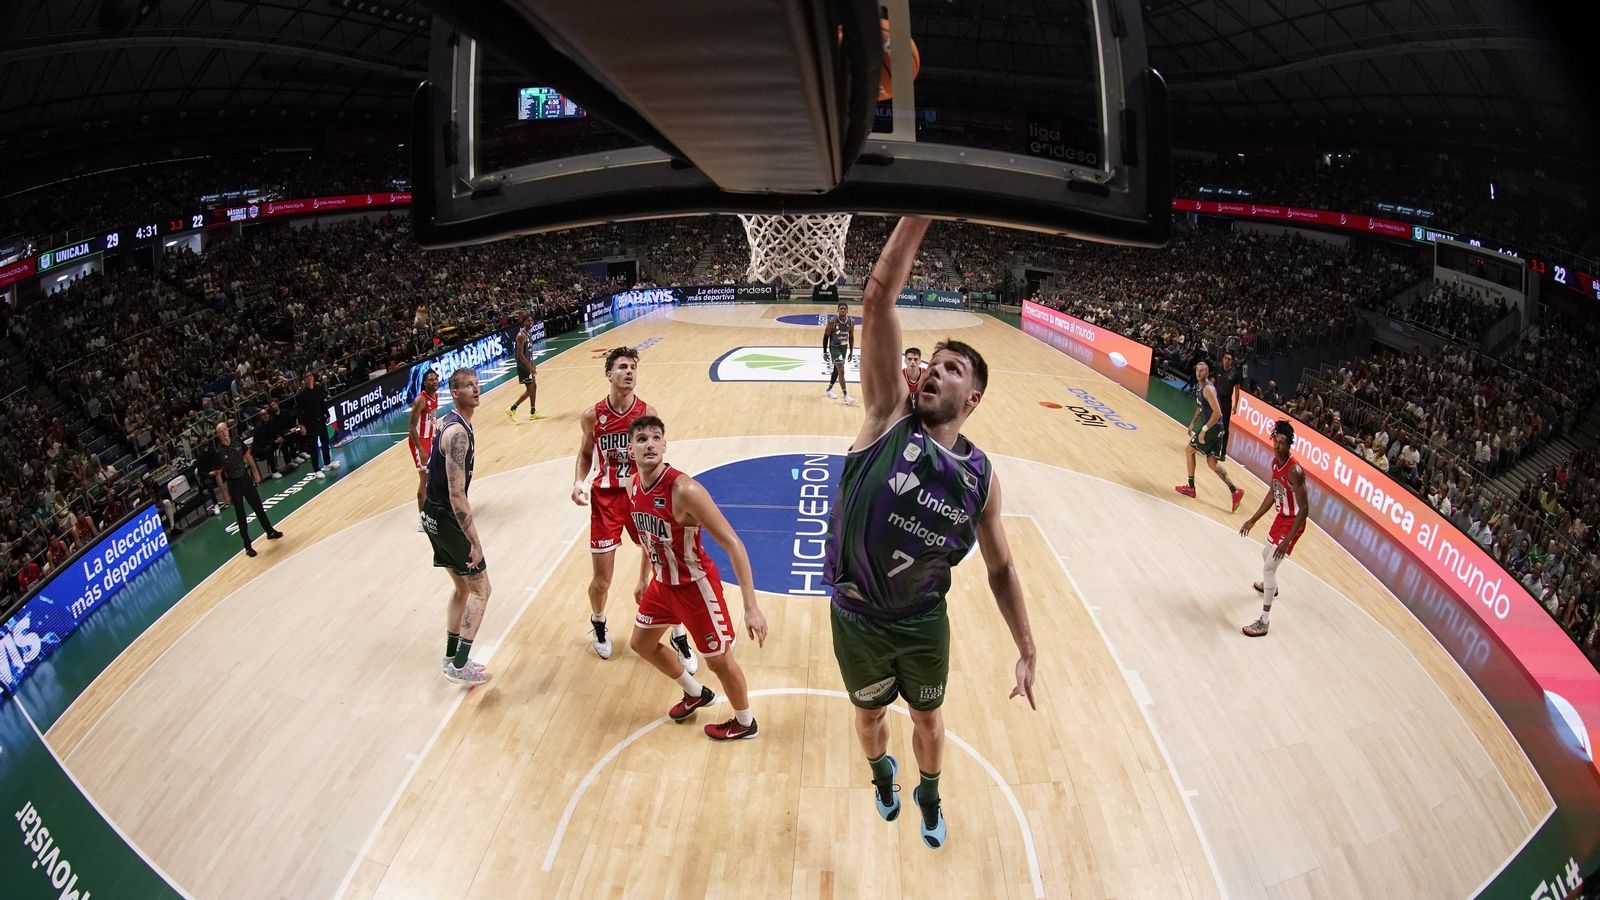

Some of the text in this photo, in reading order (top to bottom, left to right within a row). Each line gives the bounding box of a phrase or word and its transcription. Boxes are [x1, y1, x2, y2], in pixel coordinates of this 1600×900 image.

[1029, 122, 1060, 141] liga
[1029, 140, 1097, 165] endesa
[56, 214, 204, 263] UNICAJA 29 4:31 3.3 22
[1554, 265, 1566, 284] 22
[703, 294, 735, 302] deportiva
[737, 286, 772, 294] endesa
[938, 296, 960, 304] Unicaja
[1055, 316, 1070, 331] marca
[1076, 324, 1095, 342] mundo
[340, 385, 382, 416] The most
[344, 403, 381, 430] sportive
[600, 433, 628, 451] GIRO
[616, 462, 631, 478] 22
[917, 488, 969, 525] Unicaja
[84, 514, 162, 581] La elección
[1333, 456, 1353, 487] tu
[1354, 473, 1414, 534] marca
[1417, 523, 1439, 552] al
[1437, 539, 1510, 620] mundo
[71, 532, 168, 619] más deportiva
[887, 550, 915, 578] 7
